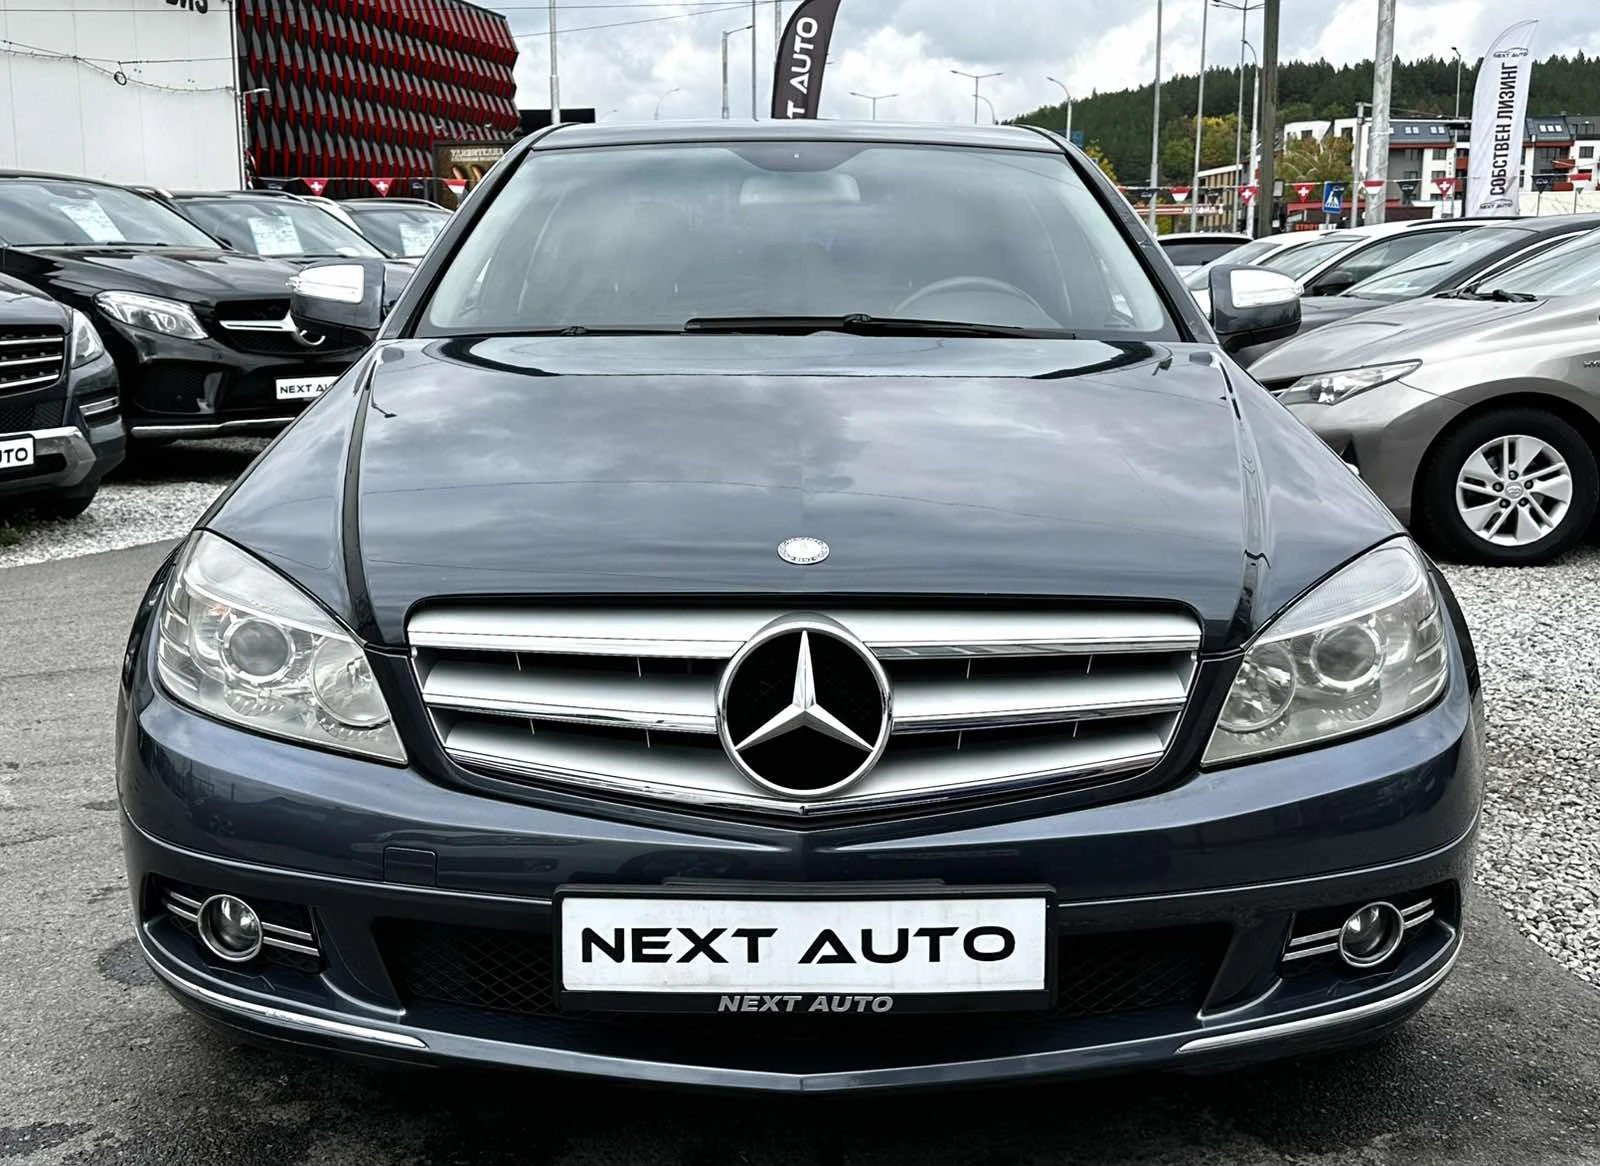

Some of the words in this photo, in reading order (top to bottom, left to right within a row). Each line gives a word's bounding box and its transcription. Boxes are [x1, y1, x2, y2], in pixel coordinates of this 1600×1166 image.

[789, 17, 818, 95] AUTO
[1497, 62, 1518, 120] ЛИЗИНГ
[1490, 124, 1511, 196] СОБСТВЕН
[280, 384, 312, 394] NEXT
[581, 927, 777, 964] NEXT
[797, 926, 1016, 964] AUTO
[718, 995, 802, 1014] NEXT
[808, 995, 893, 1014] AUTO
